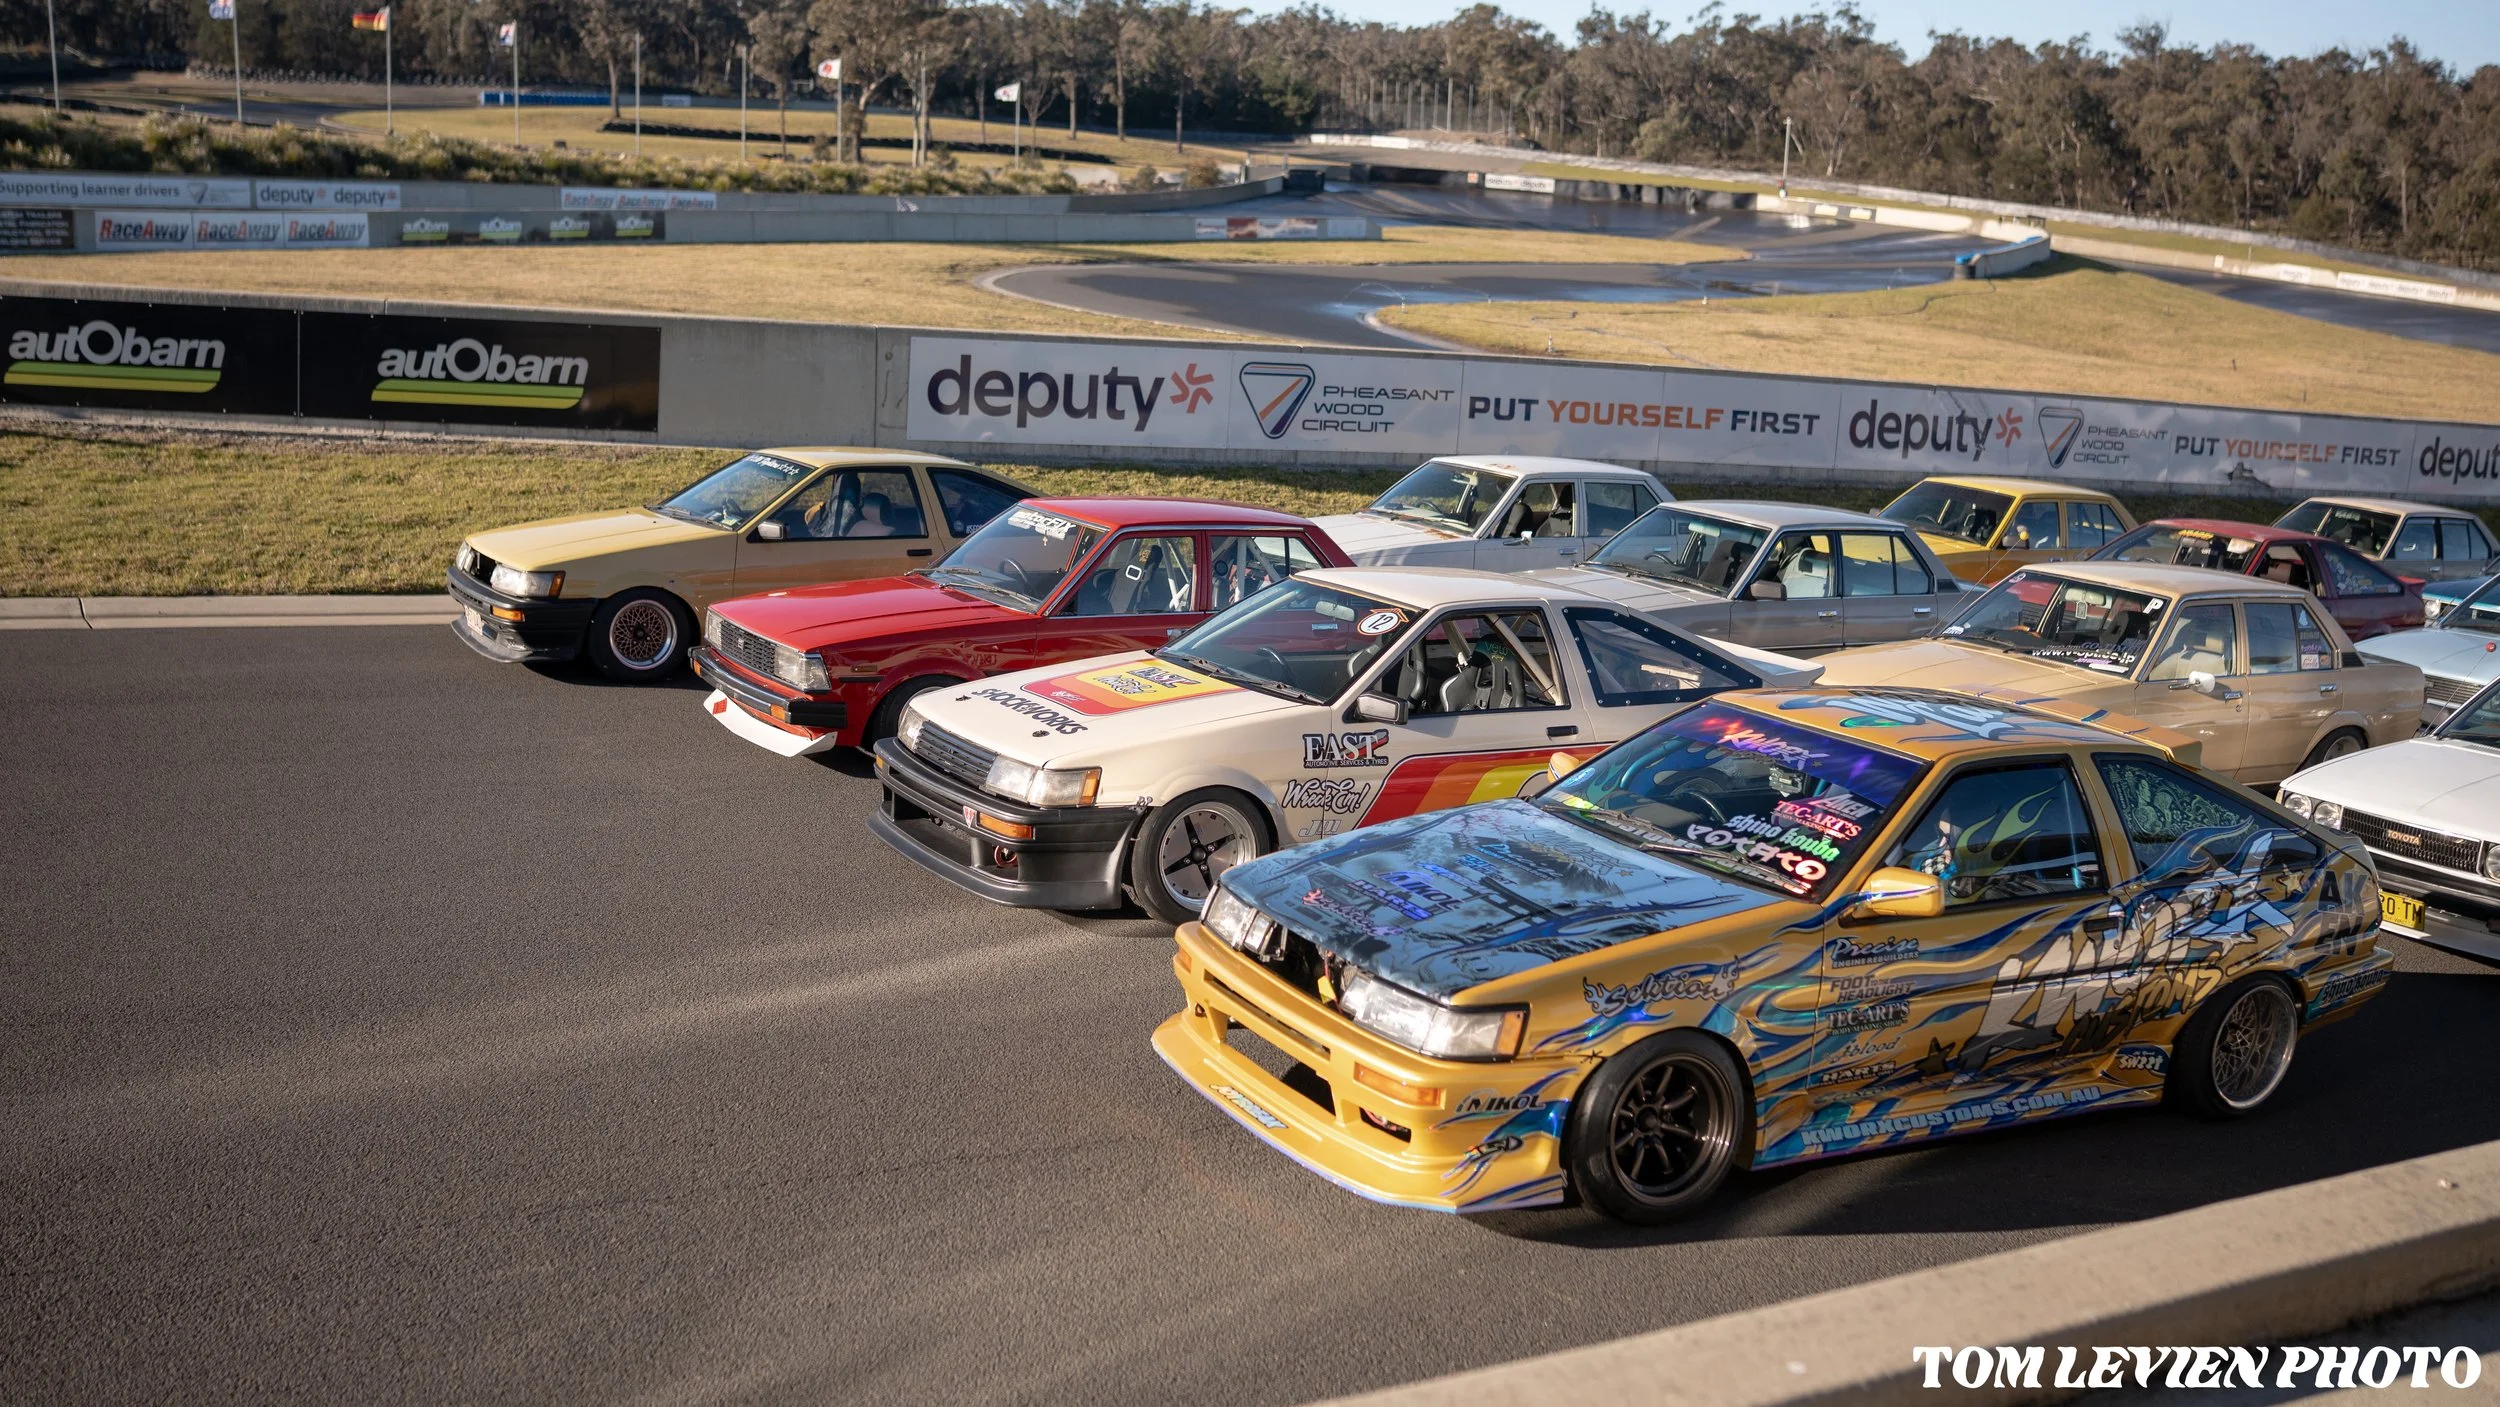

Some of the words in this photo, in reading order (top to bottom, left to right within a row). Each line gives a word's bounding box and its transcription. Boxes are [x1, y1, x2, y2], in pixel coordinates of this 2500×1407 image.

[0, 180, 79, 198] Supporting
[82, 182, 131, 195] learner
[134, 183, 181, 197] drivers
[260, 185, 315, 204] deputy
[334, 187, 386, 206] deputy
[100, 218, 190, 242] RaceAway
[197, 219, 281, 241] RaceAway
[288, 219, 366, 241] RaceAway
[927, 354, 1166, 432] deputy
[1323, 385, 1456, 402] PHEASANT
[1313, 402, 1384, 416] WOOD
[1468, 396, 1539, 422] PUT
[1546, 399, 1725, 430] YOURSELF
[1730, 410, 1820, 436] FIRST
[1301, 418, 1395, 434] CIRCUIT
[1848, 399, 1993, 462] deputy
[2087, 425, 2169, 441] PHEASANT
[2080, 438, 2125, 452] WOOD
[2174, 436, 2220, 457] PUT
[2225, 439, 2338, 464] YOURSELF
[2341, 447, 2401, 468] FIRST
[2073, 451, 2131, 466] CIRCUIT
[2142, 597, 2164, 614] P
[1367, 614, 1394, 630] 12
[1303, 734, 1380, 762] EAST
[1340, 759, 1364, 767] SERVICES
[1372, 757, 1388, 766] TYRES
[1774, 800, 1863, 838] TEC-ART'S
[2387, 829, 2420, 845] TOYOTA
[2403, 900, 2423, 923] TM
[1831, 936, 1920, 960] Precise
[1830, 975, 1875, 993] FOOT
[1837, 982, 1915, 1003] HEADLIGHT
[1828, 1000, 1910, 1028] TEC-ART'S
[1801, 1086, 2102, 1147] KWORXCUSTOMS.COM.AU
